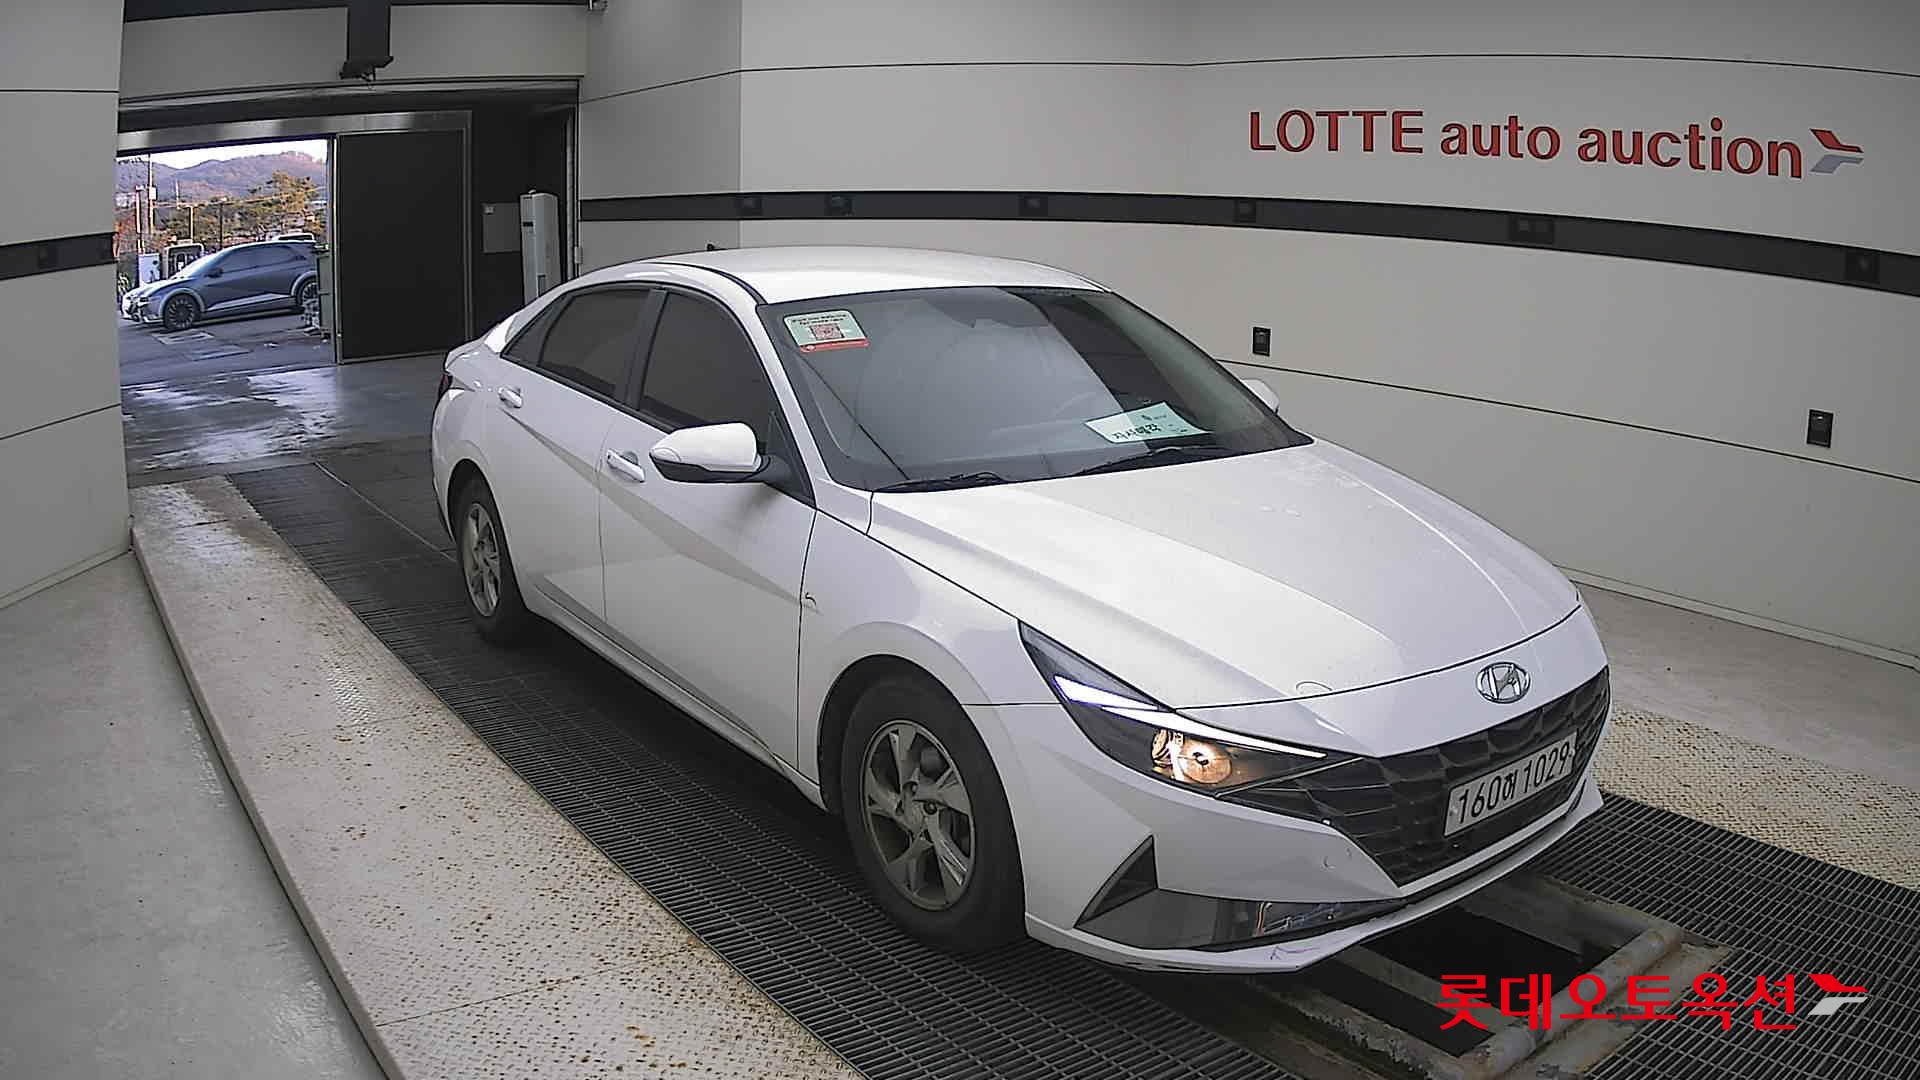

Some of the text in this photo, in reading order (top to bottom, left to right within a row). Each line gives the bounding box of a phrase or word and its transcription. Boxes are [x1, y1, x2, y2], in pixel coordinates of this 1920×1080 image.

[1249, 110, 1803, 178] LOTTE auto auction
[1523, 741, 1570, 794] 1029
